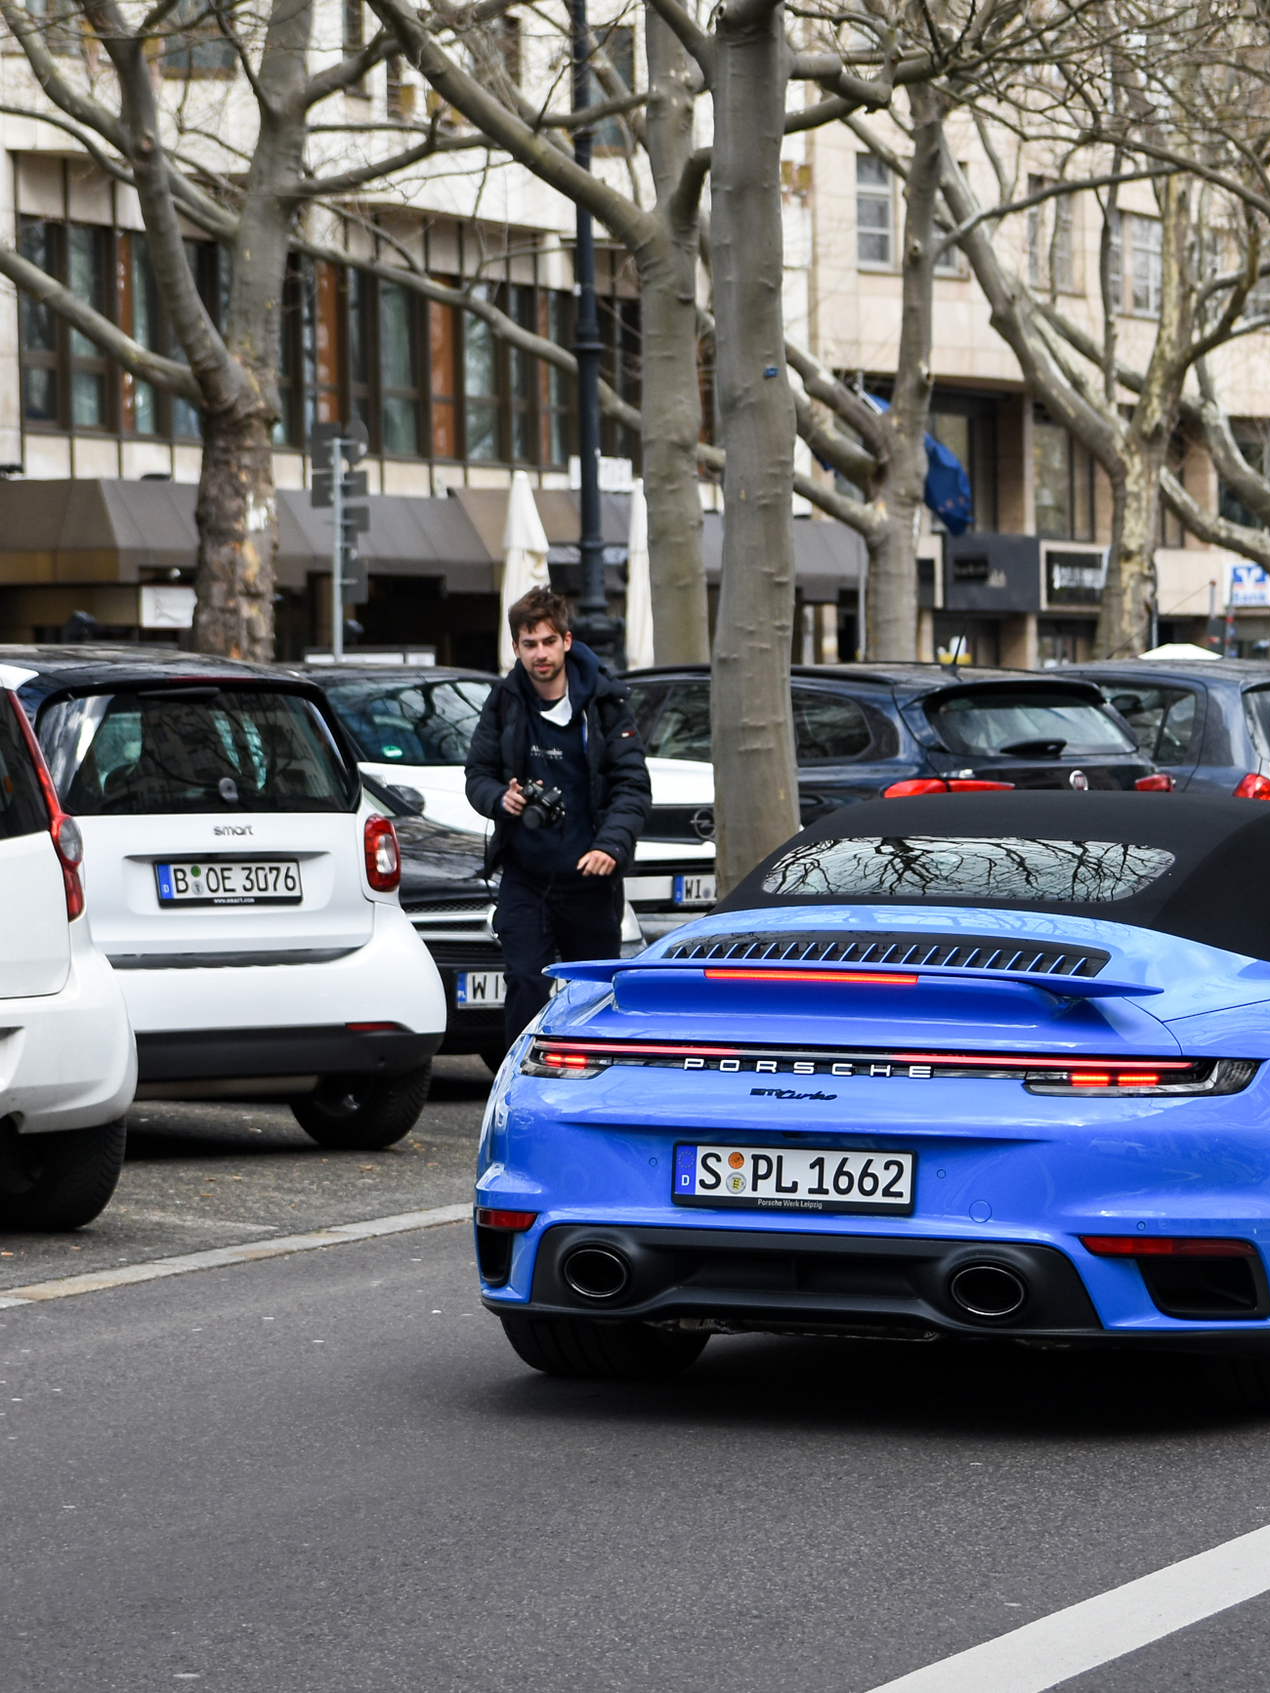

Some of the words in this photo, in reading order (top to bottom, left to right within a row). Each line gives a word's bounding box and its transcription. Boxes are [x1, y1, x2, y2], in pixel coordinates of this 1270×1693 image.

[213, 825, 254, 836] smart
[173, 868, 189, 893] B
[206, 867, 237, 893] OE
[241, 866, 297, 892] 3076
[684, 1057, 932, 1079] PORSCHE
[681, 1175, 690, 1186] D
[699, 1153, 722, 1190] S
[751, 1154, 799, 1193] PL
[807, 1157, 905, 1198] 1662
[757, 1198, 783, 1207] Porsche
[783, 1199, 800, 1207] Werk
[800, 1200, 823, 1210] Leipzig
